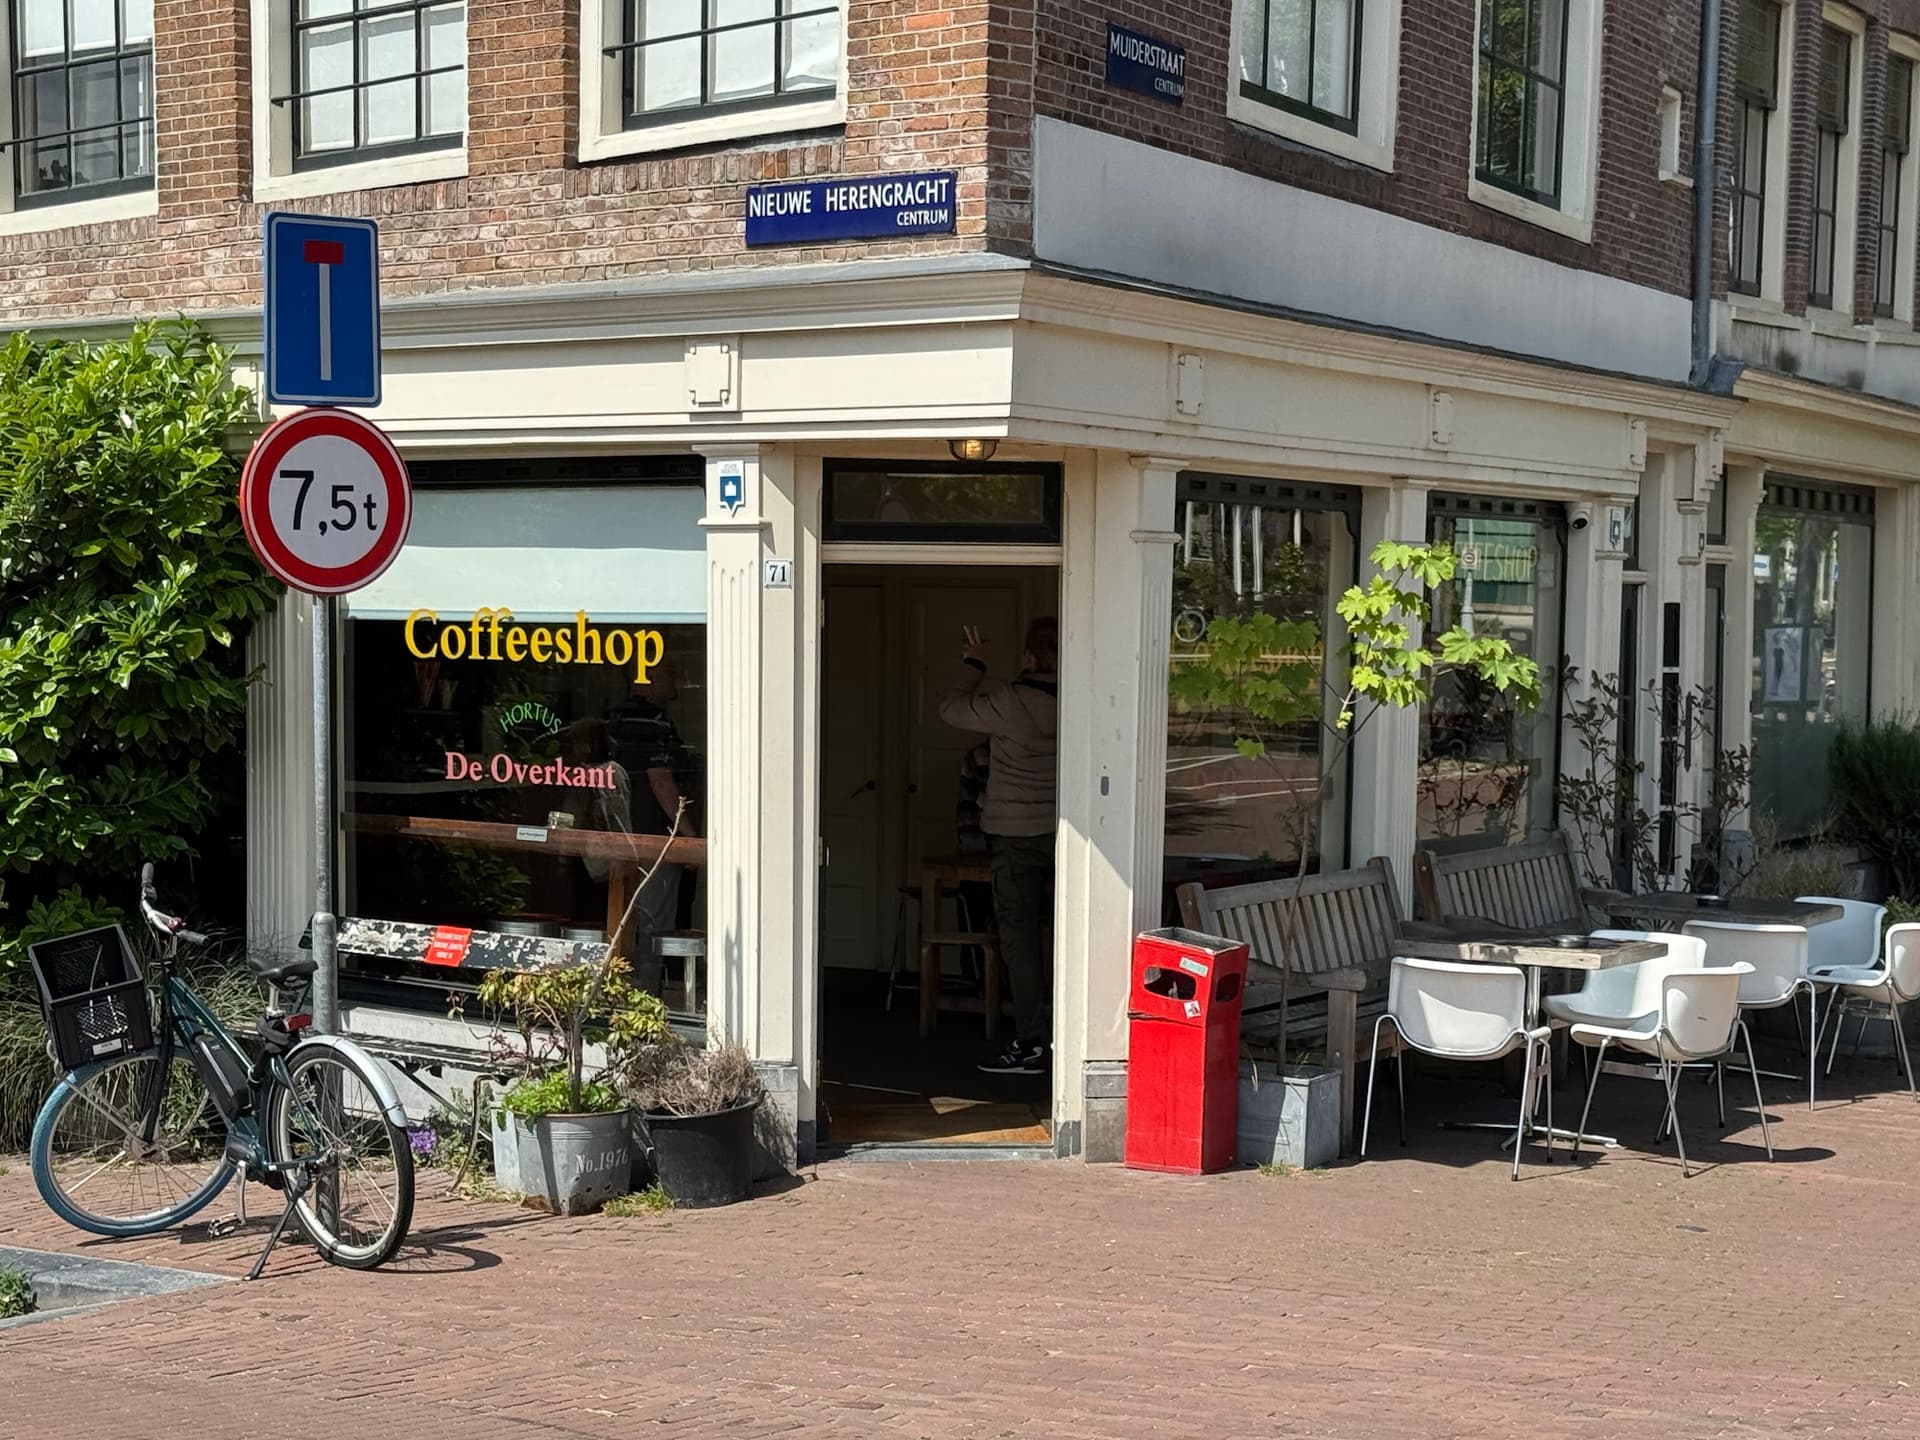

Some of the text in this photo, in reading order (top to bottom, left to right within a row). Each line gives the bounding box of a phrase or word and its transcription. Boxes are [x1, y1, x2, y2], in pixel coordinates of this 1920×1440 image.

[1110, 31, 1185, 77] MUIDERSTRAAT
[1154, 77, 1185, 98] CENTRUM
[750, 179, 950, 218] NIEUWE HERENGRACHT
[897, 209, 949, 226] CENTRUM
[769, 564, 787, 582] 71
[405, 607, 664, 684] Coffeeshop
[500, 702, 562, 734] HORTUS
[445, 751, 617, 789] De Overkant
